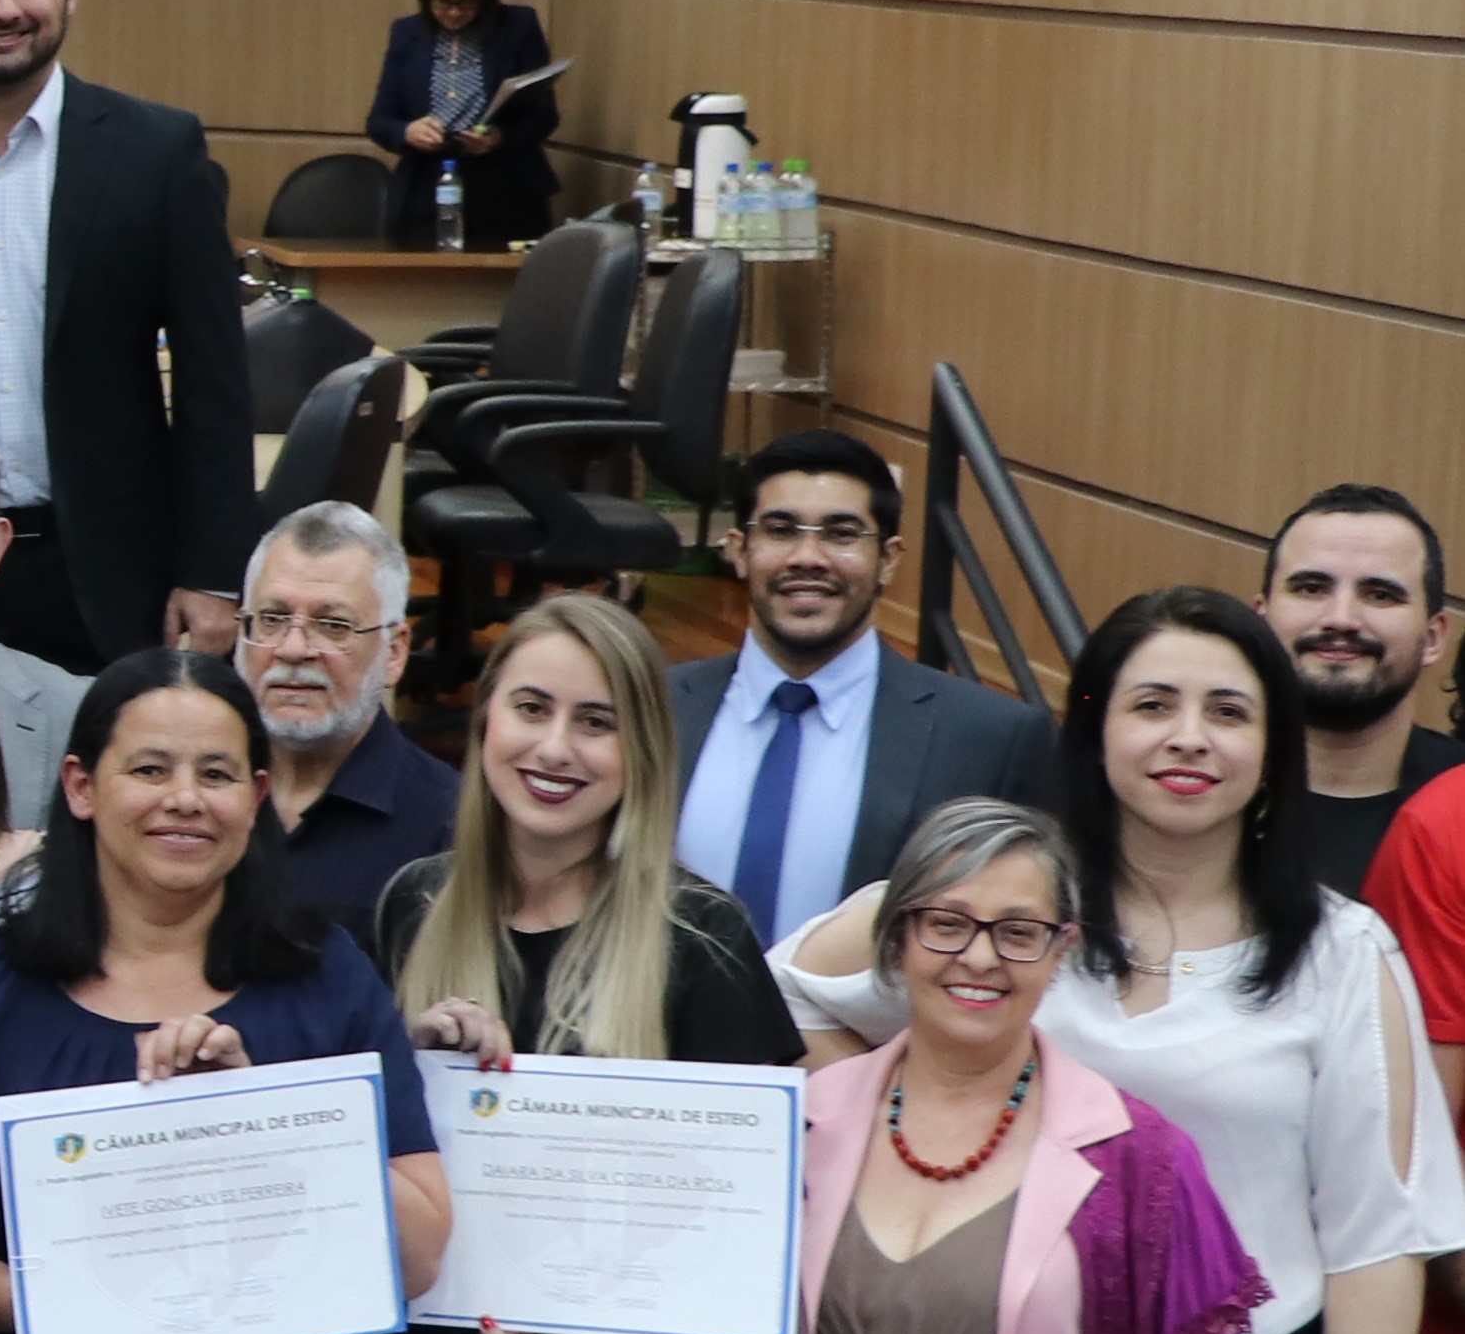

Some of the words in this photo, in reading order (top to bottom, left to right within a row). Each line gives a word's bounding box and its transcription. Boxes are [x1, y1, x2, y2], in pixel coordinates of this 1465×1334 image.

[506, 1096, 579, 1115] CÂMARA
[586, 1104, 675, 1121] MUNICIPAL
[679, 1109, 700, 1123] DE
[706, 1111, 759, 1127] ESTEIO
[93, 1127, 167, 1154] CÂMARA
[173, 1117, 263, 1144] MUNICIPAL
[267, 1114, 288, 1130] DE
[292, 1107, 346, 1128] ESTEIO
[239, 1179, 306, 1202] FERREIRA
[543, 1167, 563, 1179] DA
[569, 1168, 608, 1183] SILVA
[612, 1171, 663, 1186] COSTA
[667, 1175, 688, 1189] DA
[693, 1177, 734, 1191] ROSA
